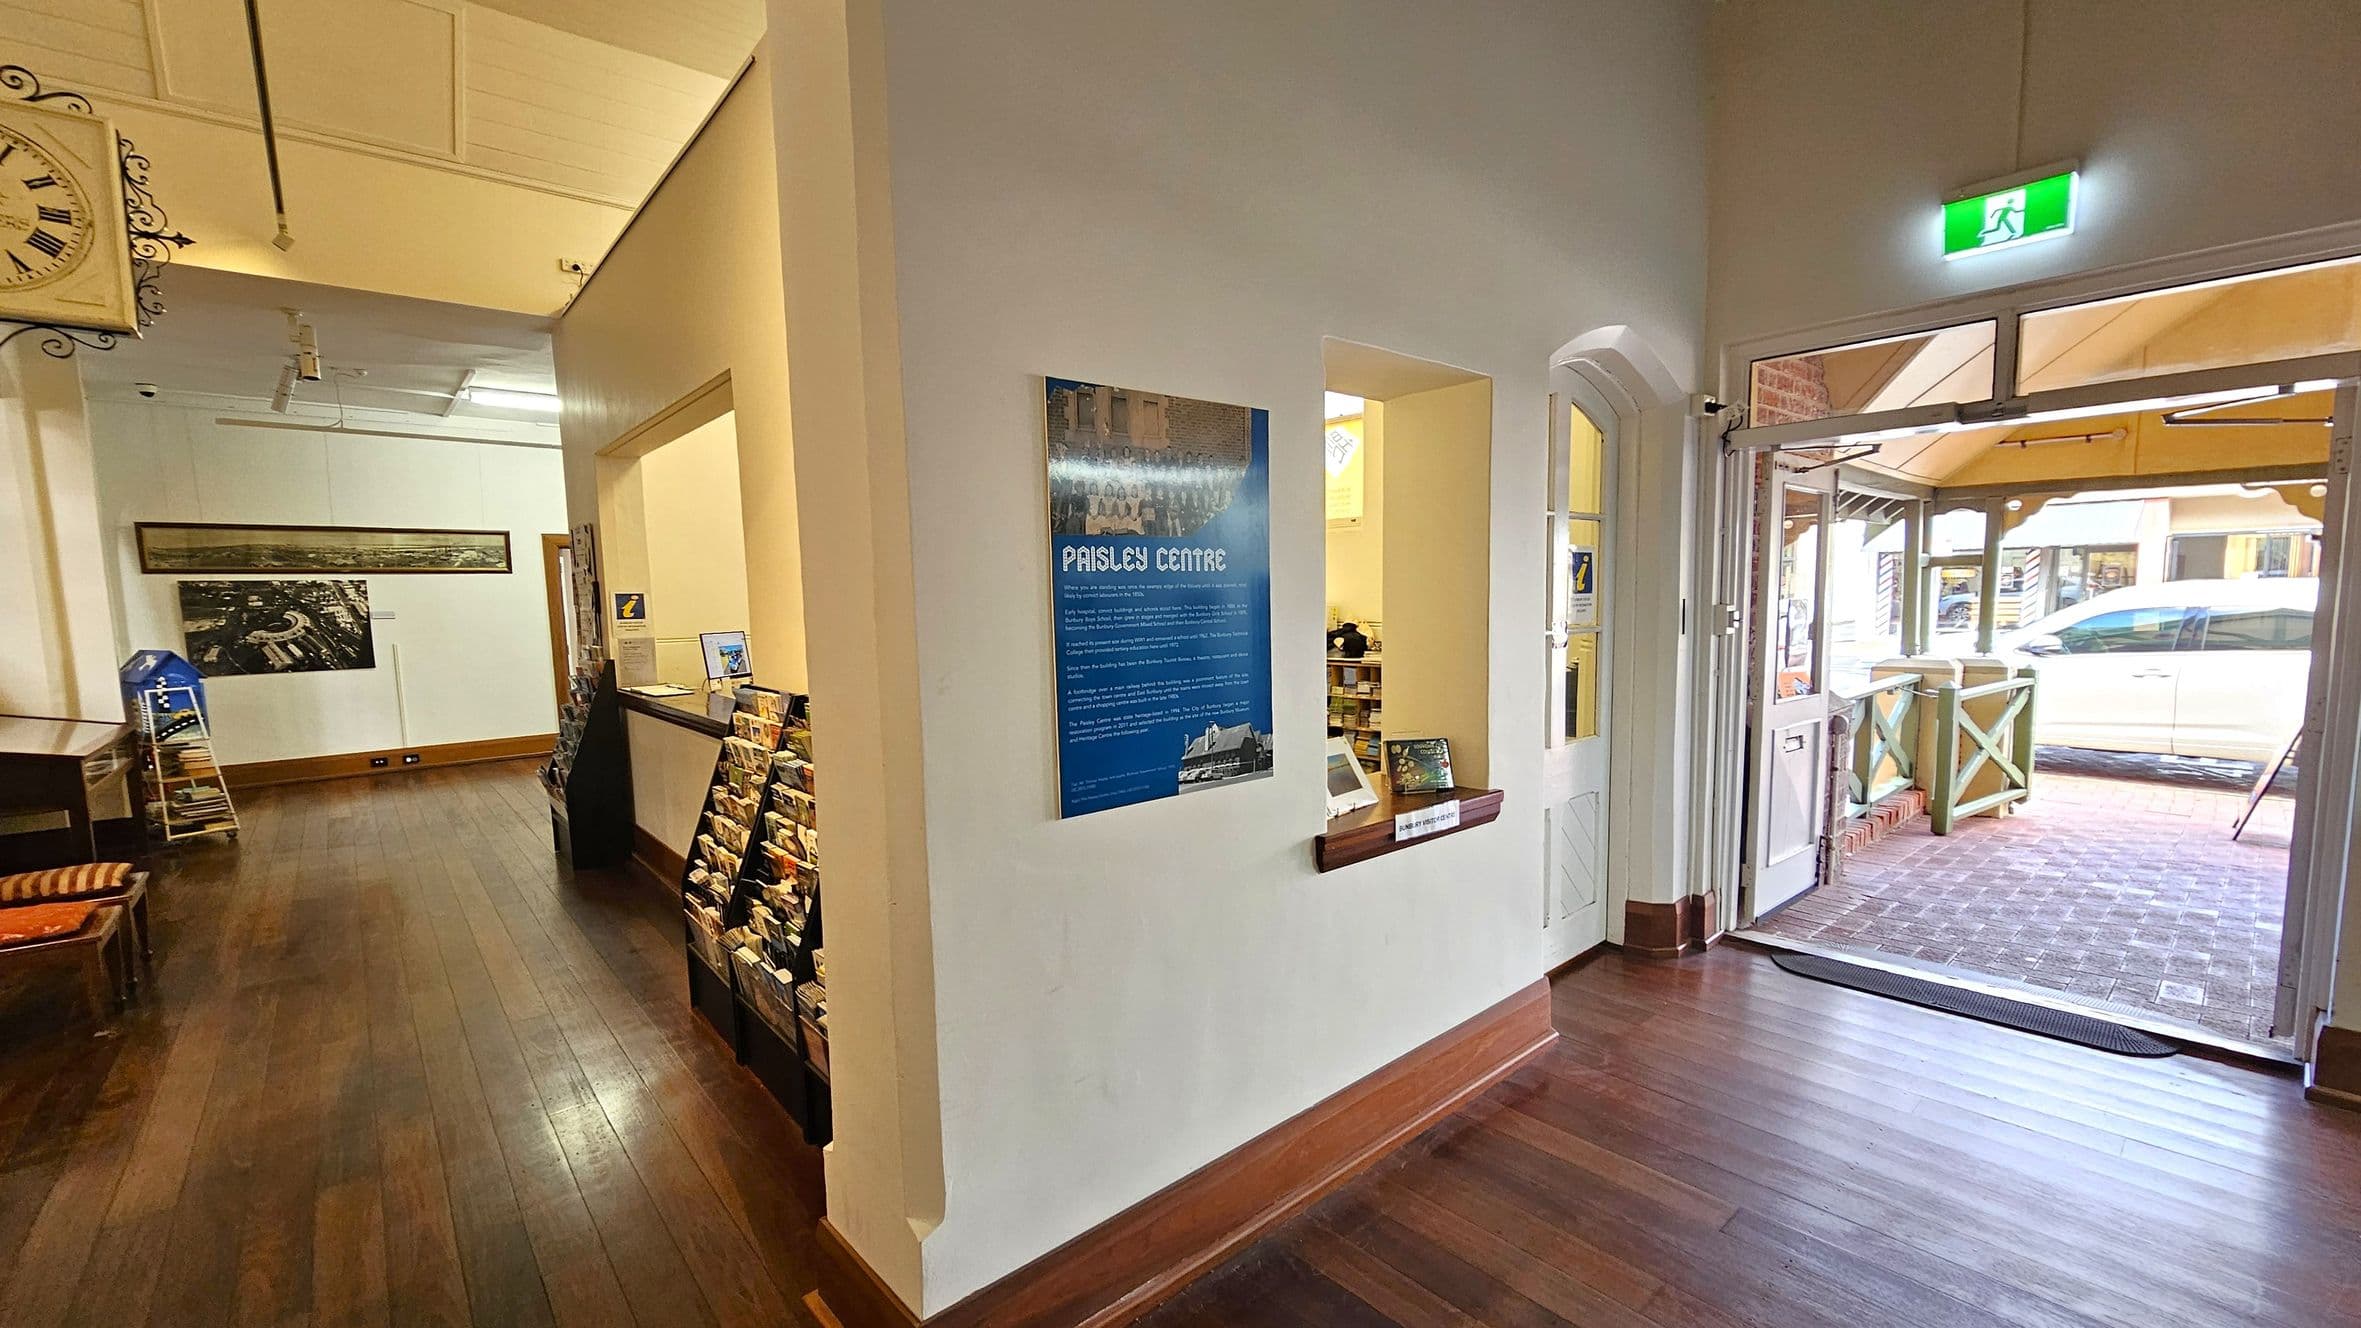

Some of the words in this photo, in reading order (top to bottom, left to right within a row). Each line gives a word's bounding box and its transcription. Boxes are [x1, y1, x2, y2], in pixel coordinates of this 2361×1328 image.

[21, 174, 59, 191] II
[36, 203, 72, 226] III
[24, 226, 68, 259] IIII
[5, 249, 34, 274] V
[1062, 545, 1148, 572] PAISLEY
[1156, 546, 1227, 572] CENTRE
